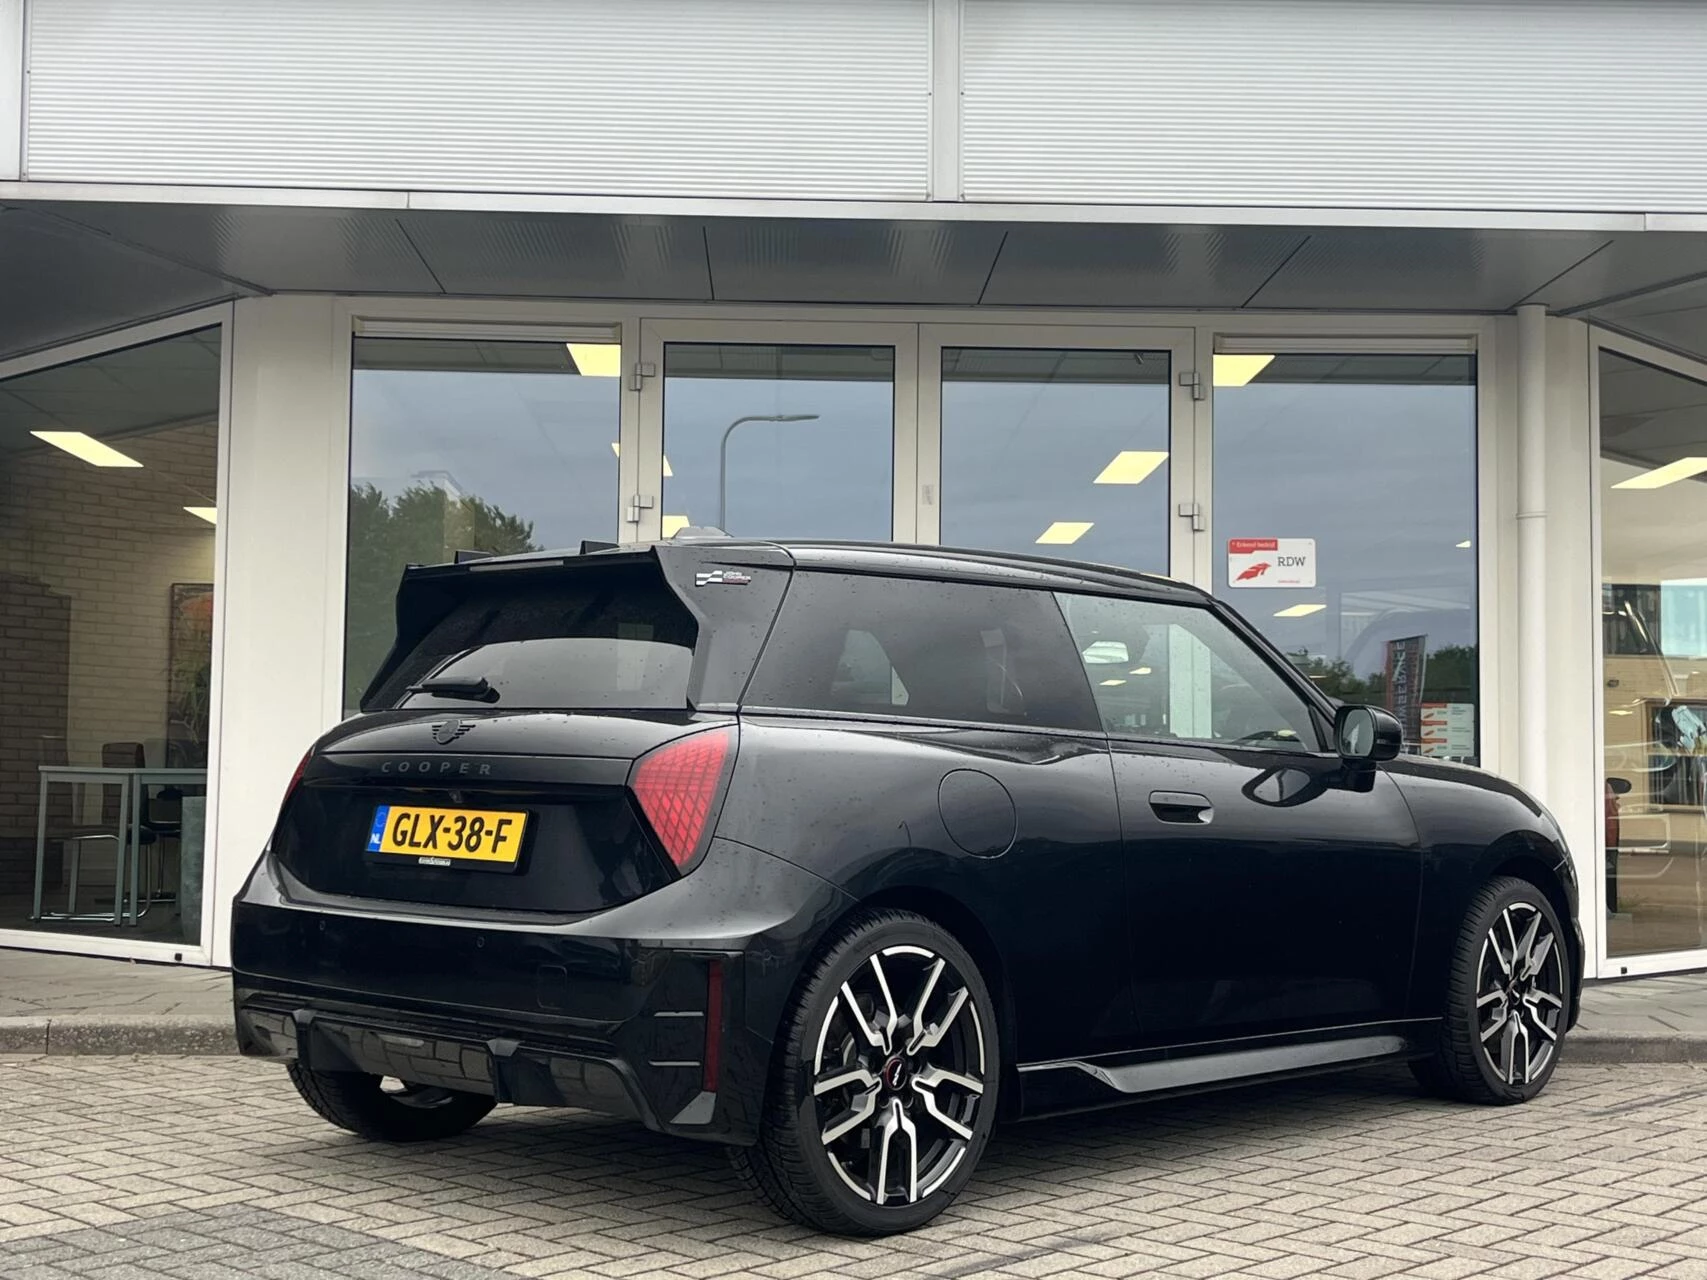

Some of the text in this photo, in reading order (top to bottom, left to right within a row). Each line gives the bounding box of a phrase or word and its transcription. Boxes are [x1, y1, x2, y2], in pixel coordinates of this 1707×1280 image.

[1277, 556, 1306, 567] RDW
[382, 761, 491, 775] COOPER
[392, 812, 513, 853] GLX-38-F
[370, 834, 381, 844] NL
